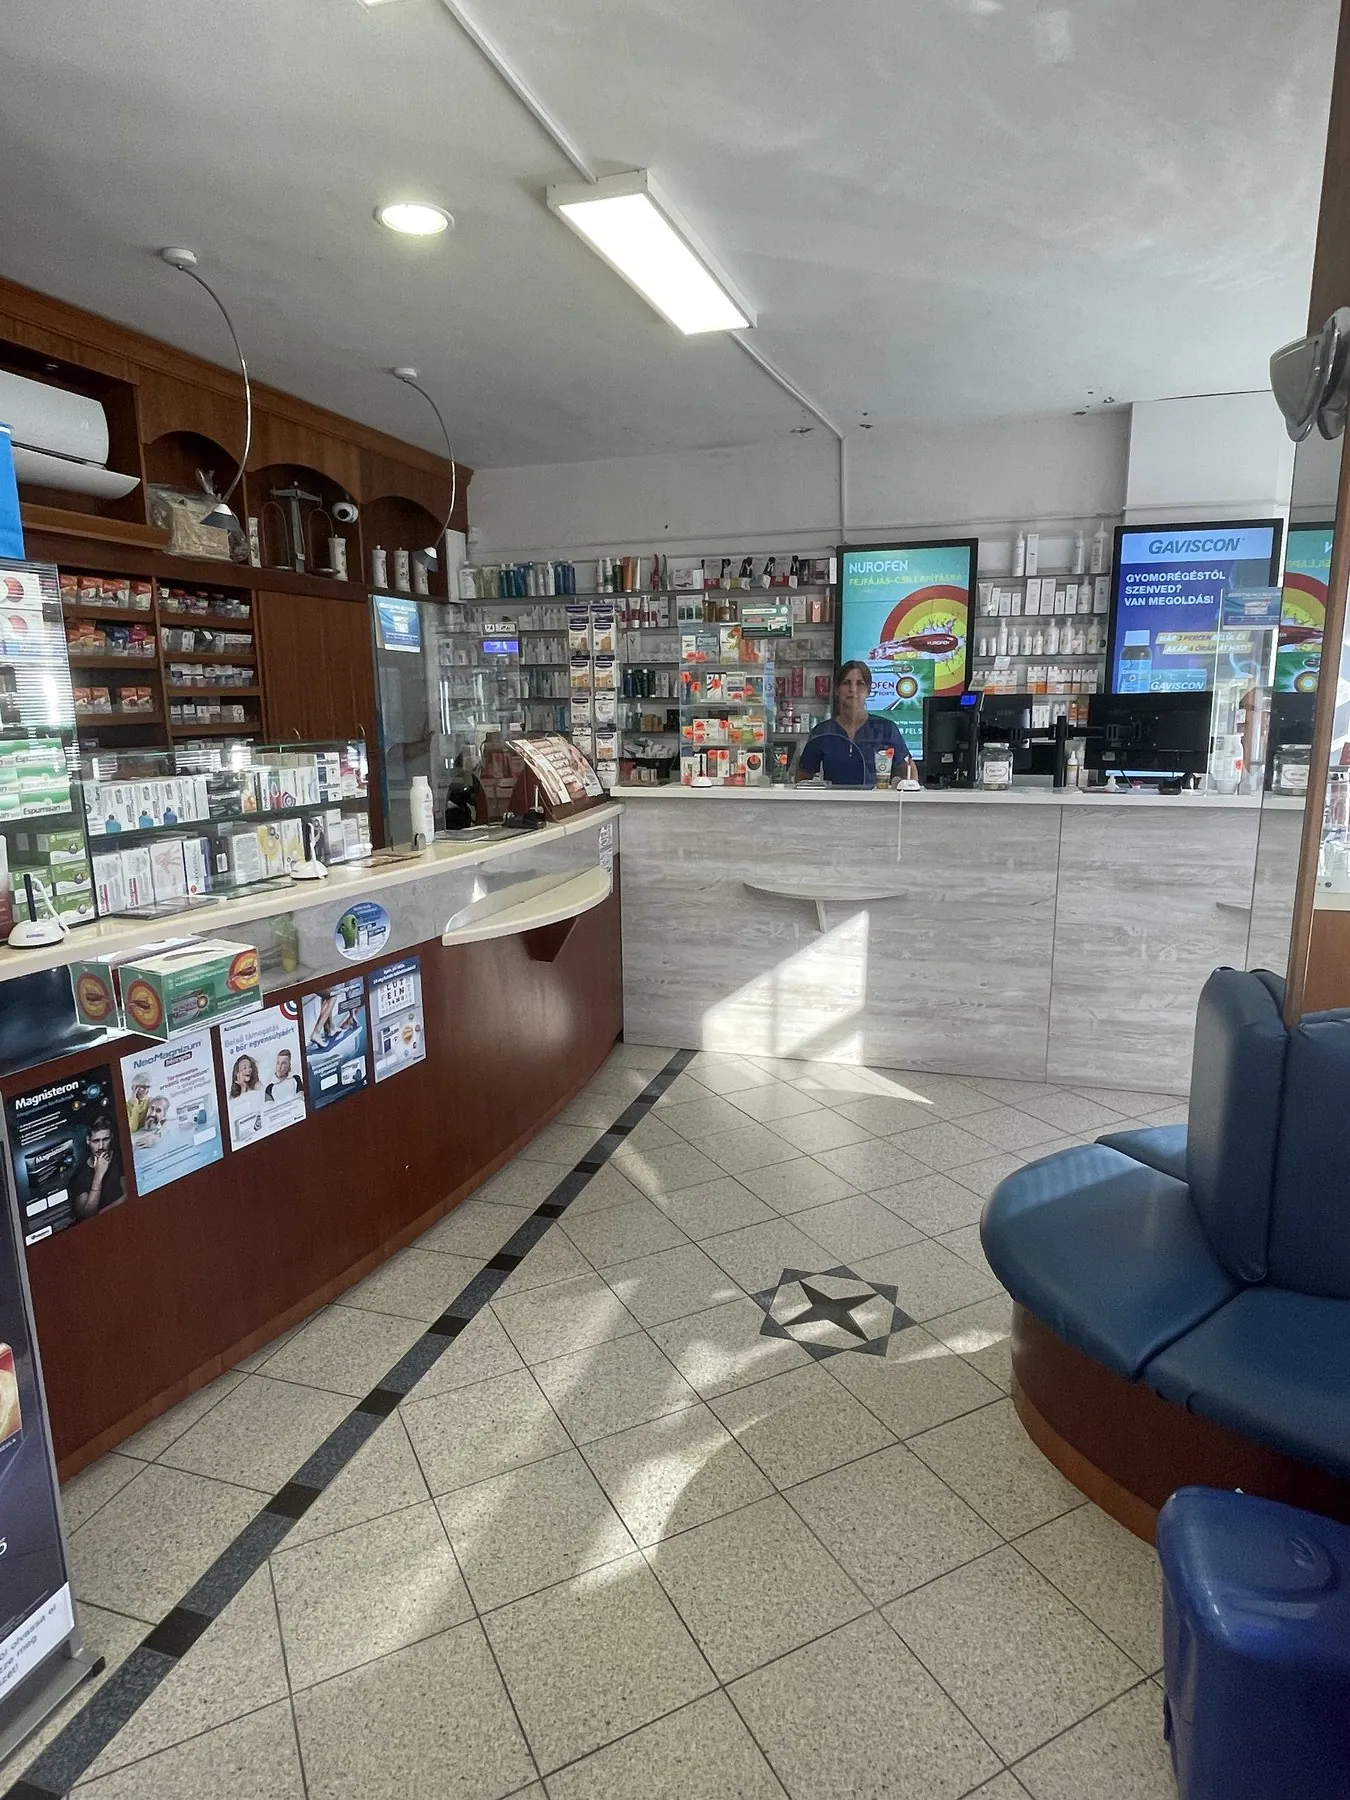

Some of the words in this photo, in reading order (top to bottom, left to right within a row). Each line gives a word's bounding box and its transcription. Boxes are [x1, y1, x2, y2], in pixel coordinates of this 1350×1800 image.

[1149, 538, 1240, 554] GAVISCON
[848, 560, 908, 573] NUROFEN
[1125, 585, 1182, 595] SZENVED?
[1124, 597, 1146, 606] VAN
[1148, 595, 1214, 606] MEGOLDÁS!
[871, 681, 895, 689] OFEN
[1151, 681, 1204, 690] GAVISCON
[23, 805, 60, 815] Espumisan
[133, 1041, 201, 1069] NeoMagnizum
[15, 1081, 79, 1110] Magnisteron
